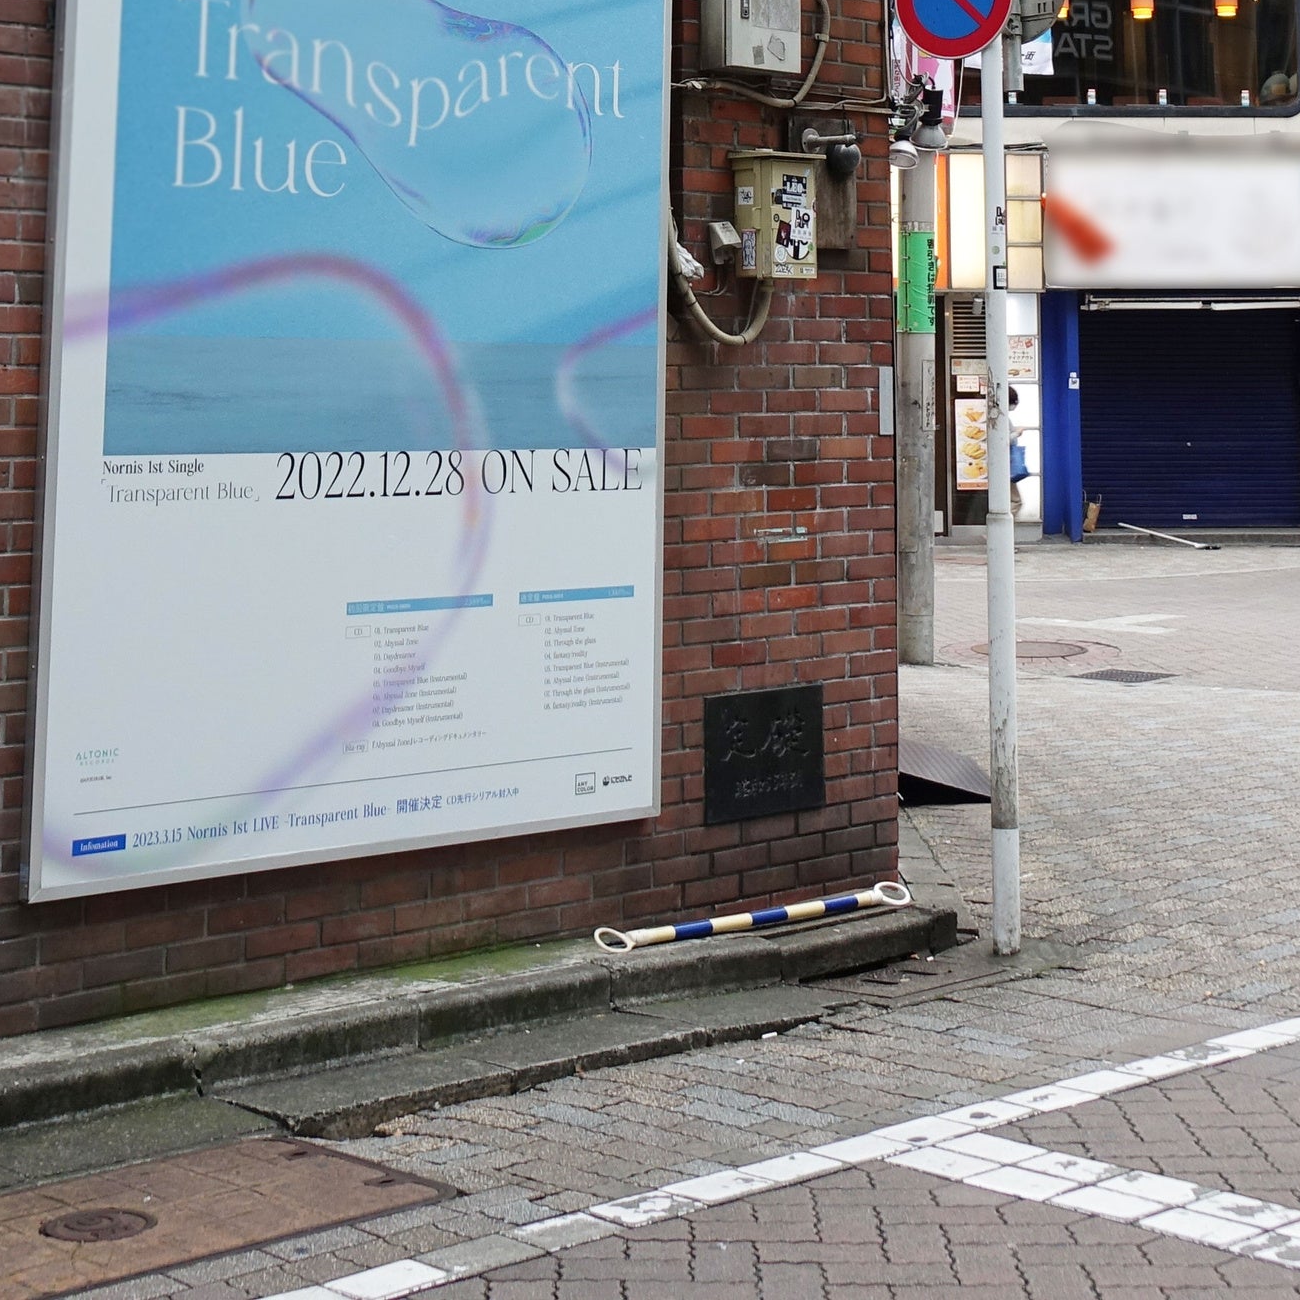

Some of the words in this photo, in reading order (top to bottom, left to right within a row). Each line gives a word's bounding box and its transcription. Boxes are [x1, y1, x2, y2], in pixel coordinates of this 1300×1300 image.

[171, 106, 347, 197] Blue
[102, 460, 143, 475] Nornis
[167, 458, 205, 476] Single
[275, 449, 465, 500] 2022.12.28
[481, 449, 536, 495] ON
[551, 448, 643, 493] SALE
[75, 748, 119, 761] ALTONIC
[132, 827, 182, 848] 2023.3.15
[186, 822, 228, 841] Nornis
[253, 815, 279, 832] LIVE
[396, 795, 443, 814] 開催決定
